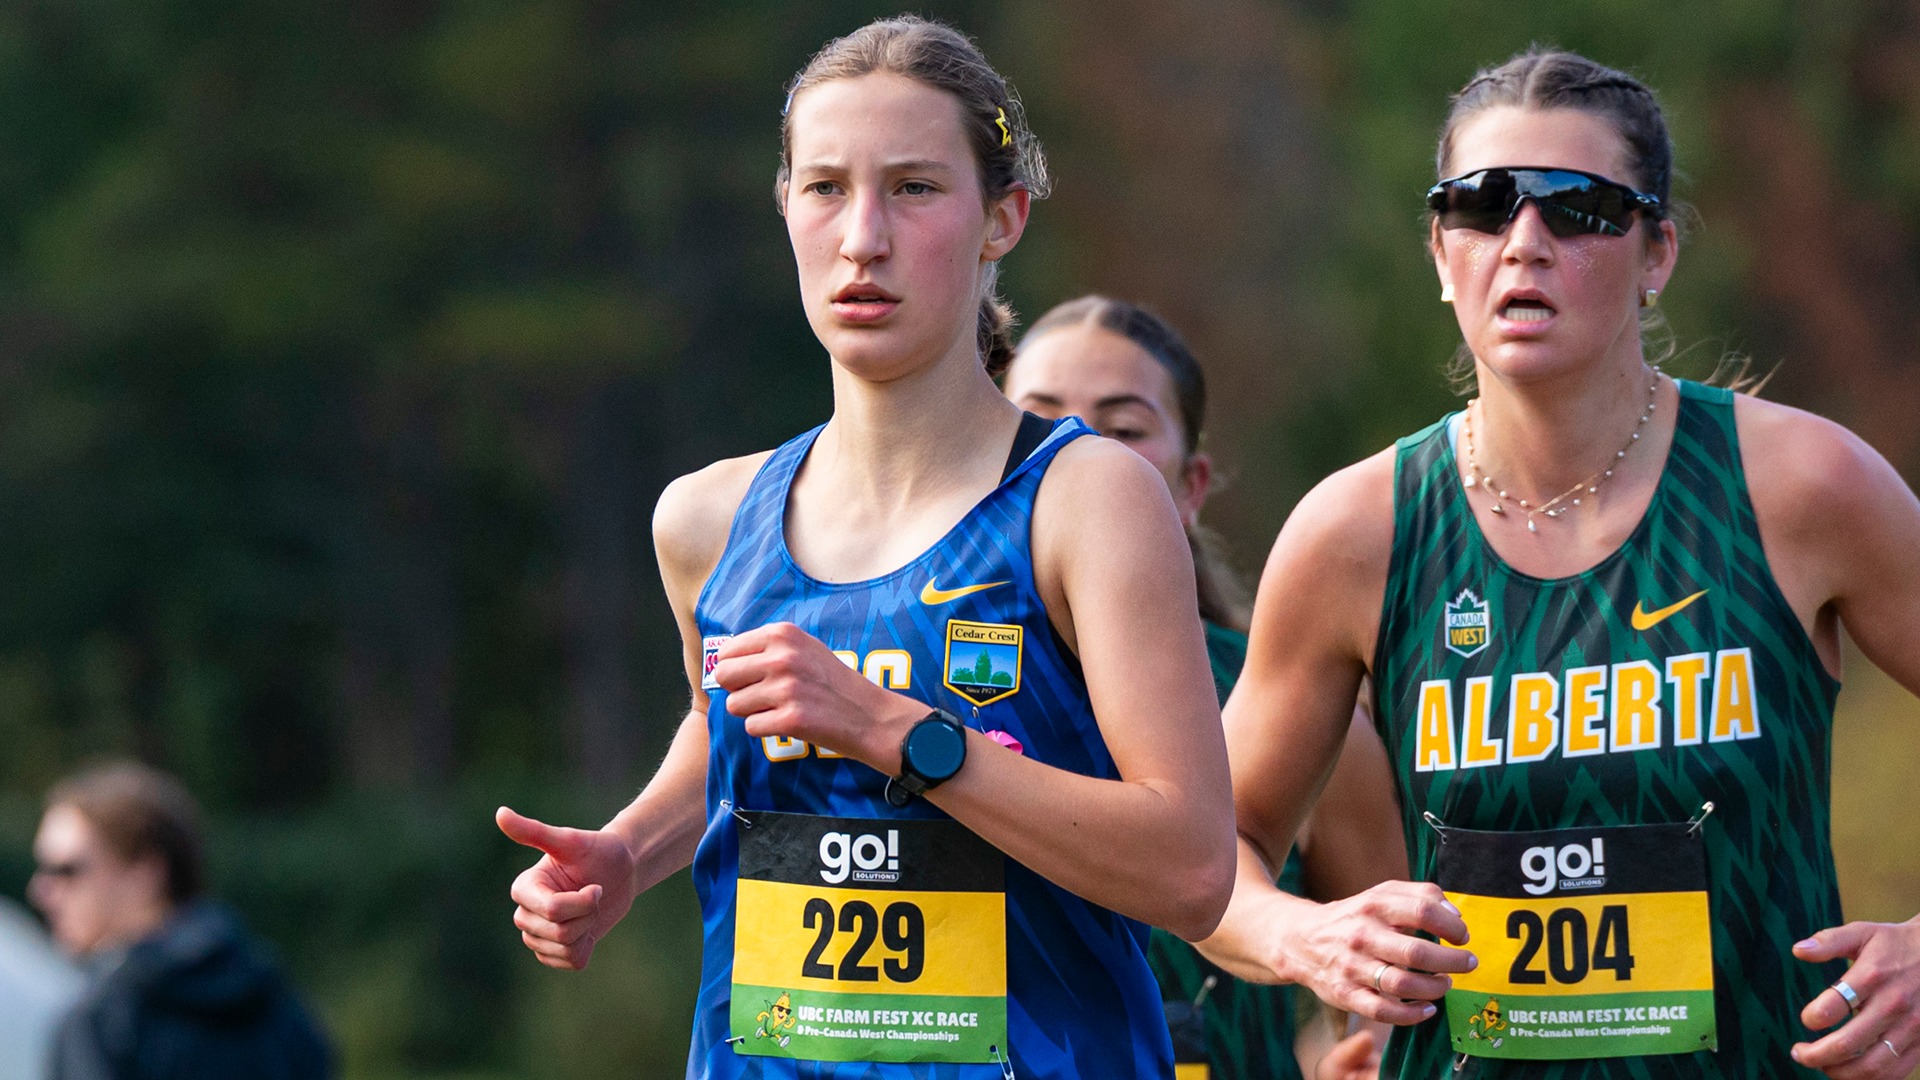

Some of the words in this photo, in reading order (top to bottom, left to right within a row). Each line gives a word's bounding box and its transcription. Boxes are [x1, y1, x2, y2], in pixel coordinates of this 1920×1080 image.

[1450, 613, 1485, 626] CANADA
[955, 627, 985, 639] Cedar
[988, 631, 1016, 641] Crest
[1450, 627, 1485, 645] WEST
[1415, 647, 1762, 772] ALBERTA
[819, 829, 899, 884] go!
[1520, 837, 1604, 895] go!
[856, 872, 896, 880] SOLUTIONS
[1562, 879, 1602, 888] SOLUTIONS
[801, 897, 925, 983] 229
[1506, 904, 1635, 985] 204
[798, 1006, 824, 1022] UBC
[826, 1008, 870, 1024] FARM
[873, 1010, 909, 1025] FEST
[911, 1011, 934, 1026] XC
[937, 1012, 978, 1027] RACE
[1508, 1010, 1537, 1024] UBC
[1540, 1010, 1583, 1024] FARM
[1587, 1008, 1621, 1023] FEST
[1624, 1007, 1646, 1021] XC
[1648, 1006, 1688, 1020] RACE
[797, 1025, 805, 1035] &
[805, 1026, 858, 1039] Pre-Canada
[859, 1029, 885, 1039] West
[886, 1029, 960, 1042] Championships
[1510, 1027, 1517, 1037] &
[1518, 1028, 1573, 1038] Pre-Canada
[1574, 1027, 1599, 1037] West
[1600, 1025, 1671, 1037] Championships
